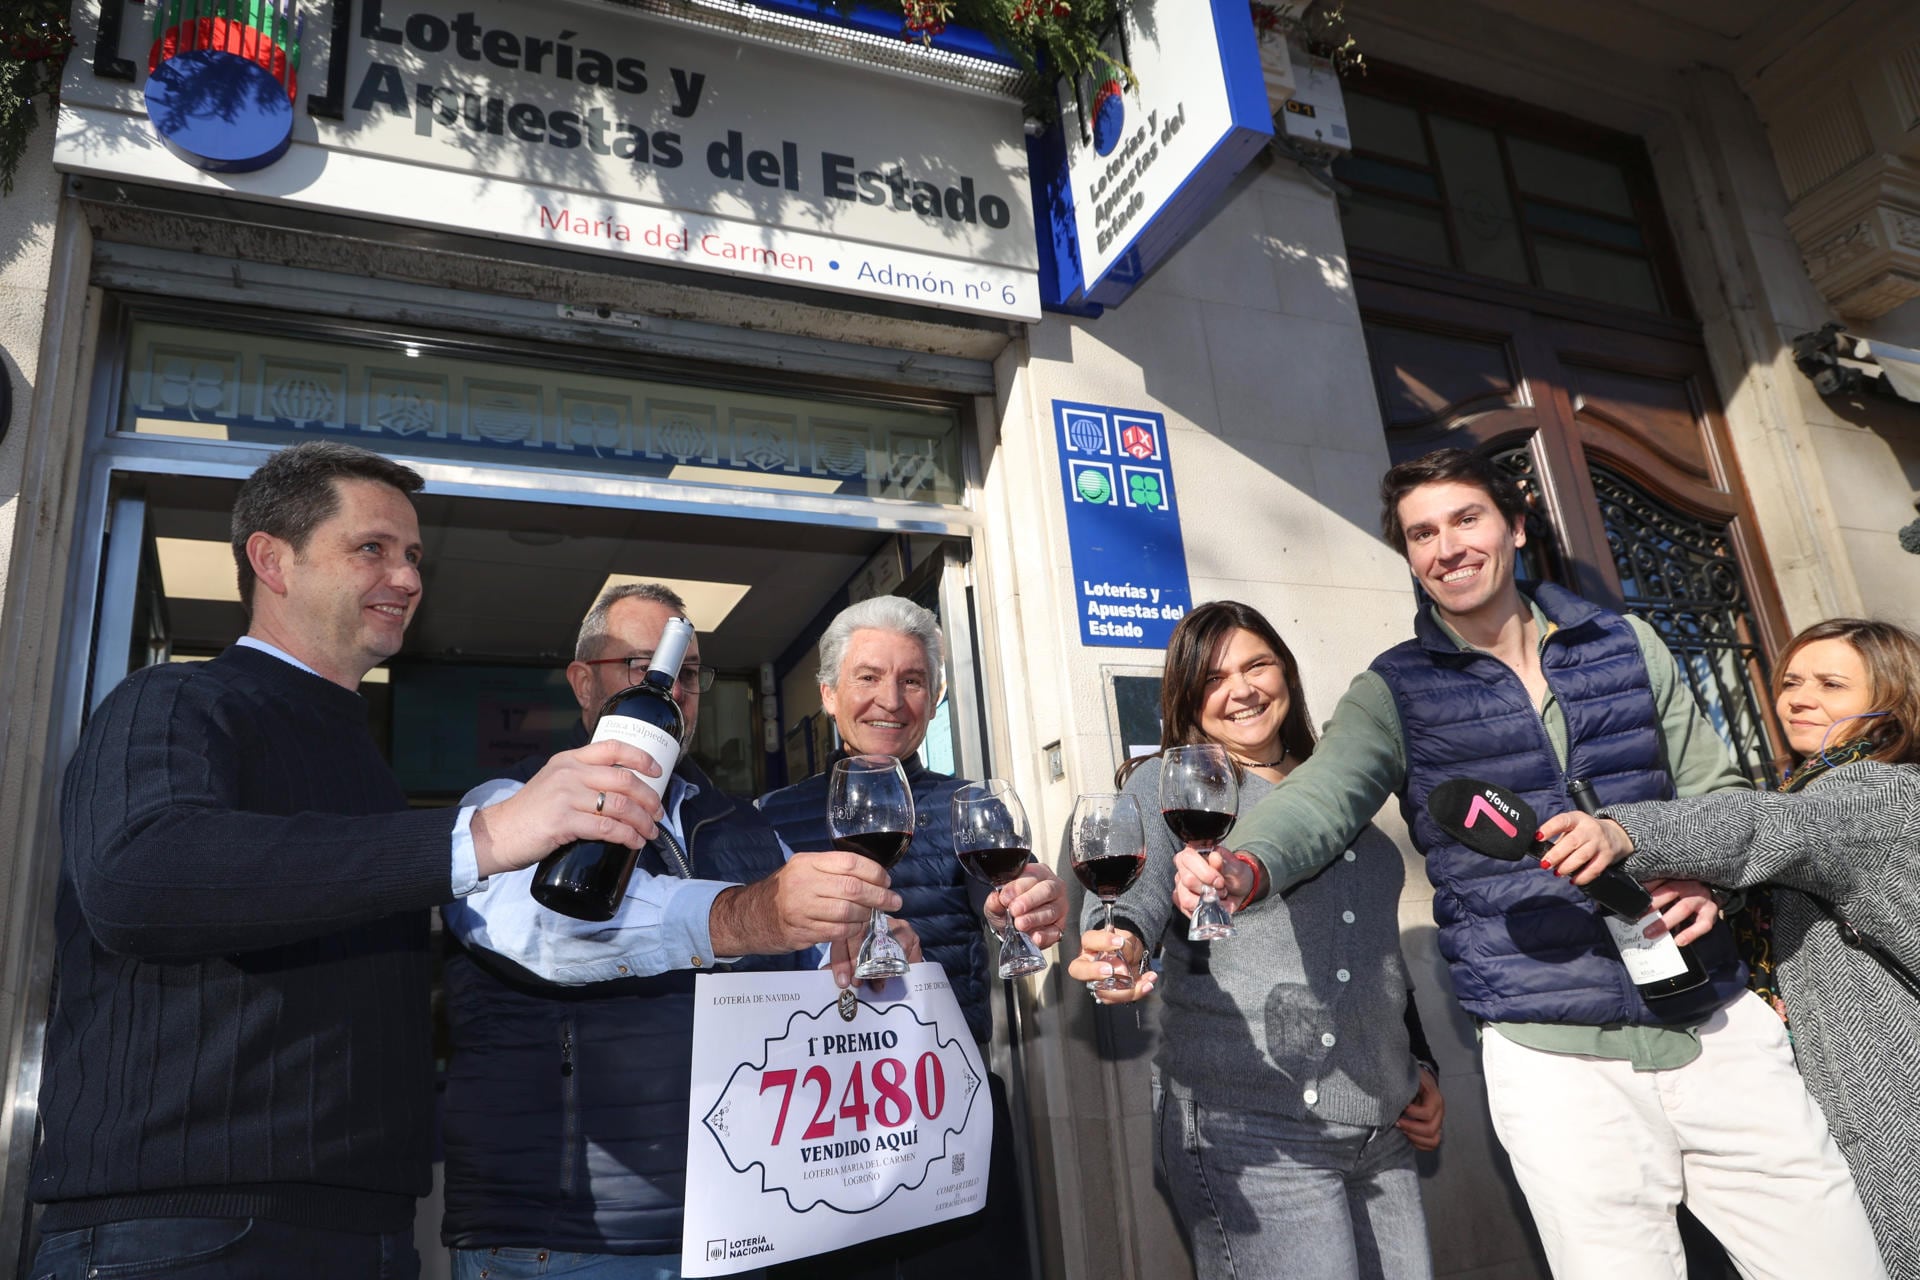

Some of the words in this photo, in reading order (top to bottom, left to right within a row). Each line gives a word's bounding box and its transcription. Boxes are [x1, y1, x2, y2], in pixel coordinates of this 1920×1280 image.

[360, 0, 647, 95] Loterías
[670, 67, 706, 119] y
[352, 62, 684, 169] Apuestas
[706, 131, 799, 192] del
[821, 151, 1011, 230] Estado
[1089, 125, 1146, 205] Loterías
[1147, 108, 1158, 137] y
[1095, 141, 1159, 229] Apuestas
[1160, 101, 1186, 147] del
[1096, 191, 1145, 256] Estado
[539, 205, 631, 243] María
[644, 224, 689, 252] del
[701, 233, 814, 273] Carmen
[857, 260, 955, 297] Admón
[965, 280, 992, 301] nº
[1001, 284, 1017, 306] 6
[1083, 580, 1148, 600] Loterías
[1150, 587, 1160, 603] y
[1087, 600, 1160, 620] Apuestas
[1161, 604, 1185, 621] del
[1088, 620, 1144, 639] Estado
[1484, 789, 1510, 814] Rioja
[713, 992, 752, 1006] LOTERÍA
[753, 994, 764, 1005] DE
[764, 993, 801, 1004] NAVIDAD
[914, 983, 924, 993] 22
[823, 1029, 898, 1056] PREMIO
[758, 1051, 945, 1146] 72480
[800, 1137, 871, 1164] VENDIDO
[875, 1125, 919, 1152] AQUÍ
[803, 1166, 840, 1181] LOTERIA
[840, 1163, 865, 1177] MARIA
[865, 1160, 882, 1173] DEL
[882, 1152, 917, 1167] CARMEN
[843, 1172, 881, 1188] LOGROÑO
[729, 1243, 775, 1259] NACIONAL
[730, 1234, 767, 1250] LOTERÍA
